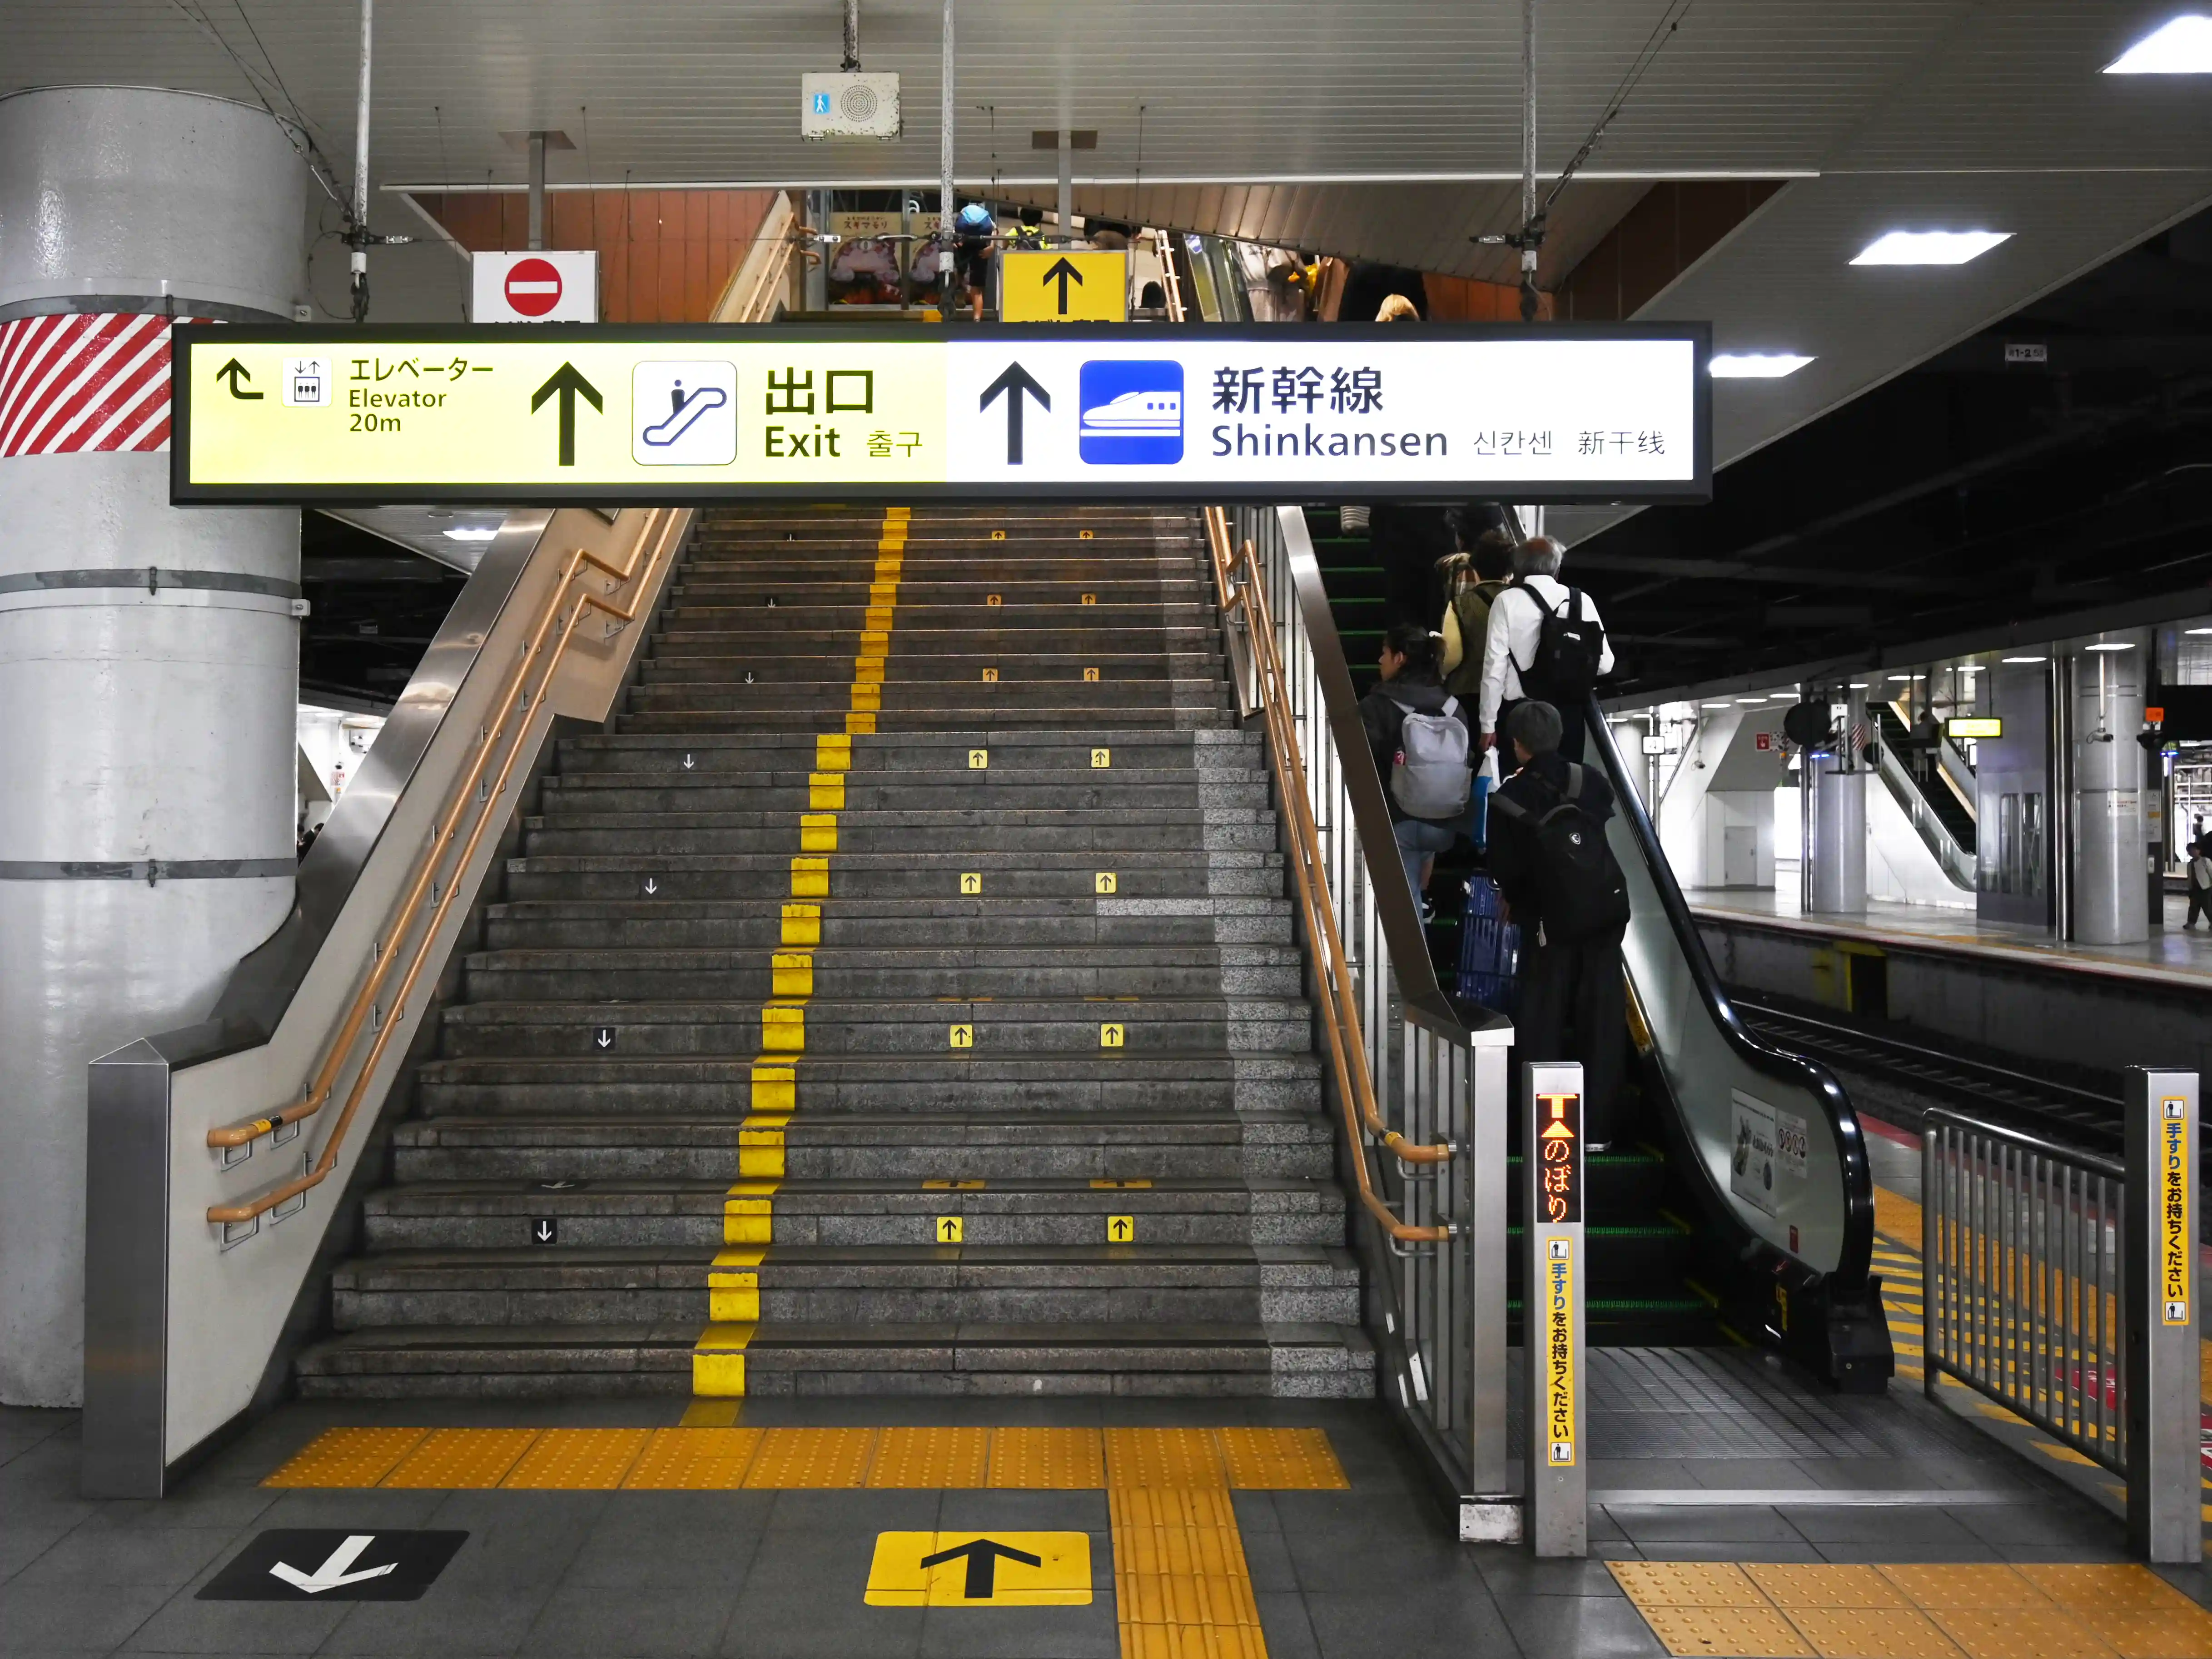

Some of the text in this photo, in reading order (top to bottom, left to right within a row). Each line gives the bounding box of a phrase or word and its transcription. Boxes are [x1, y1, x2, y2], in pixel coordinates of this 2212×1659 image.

[350, 357, 493, 381] エレベーター
[350, 388, 447, 407] Elevator
[766, 367, 873, 415] 出口
[1212, 366, 1384, 414] 新幹線
[350, 413, 401, 432] 20m
[766, 424, 923, 457] Exit 출구
[1212, 423, 1665, 457] Shinkansen 신칸센 新干线
[1545, 1140, 1571, 1223] のぼり
[2166, 1123, 2183, 1297] 手すりをお持ちください
[1551, 1263, 1569, 1438] 手すりをお持ちください
